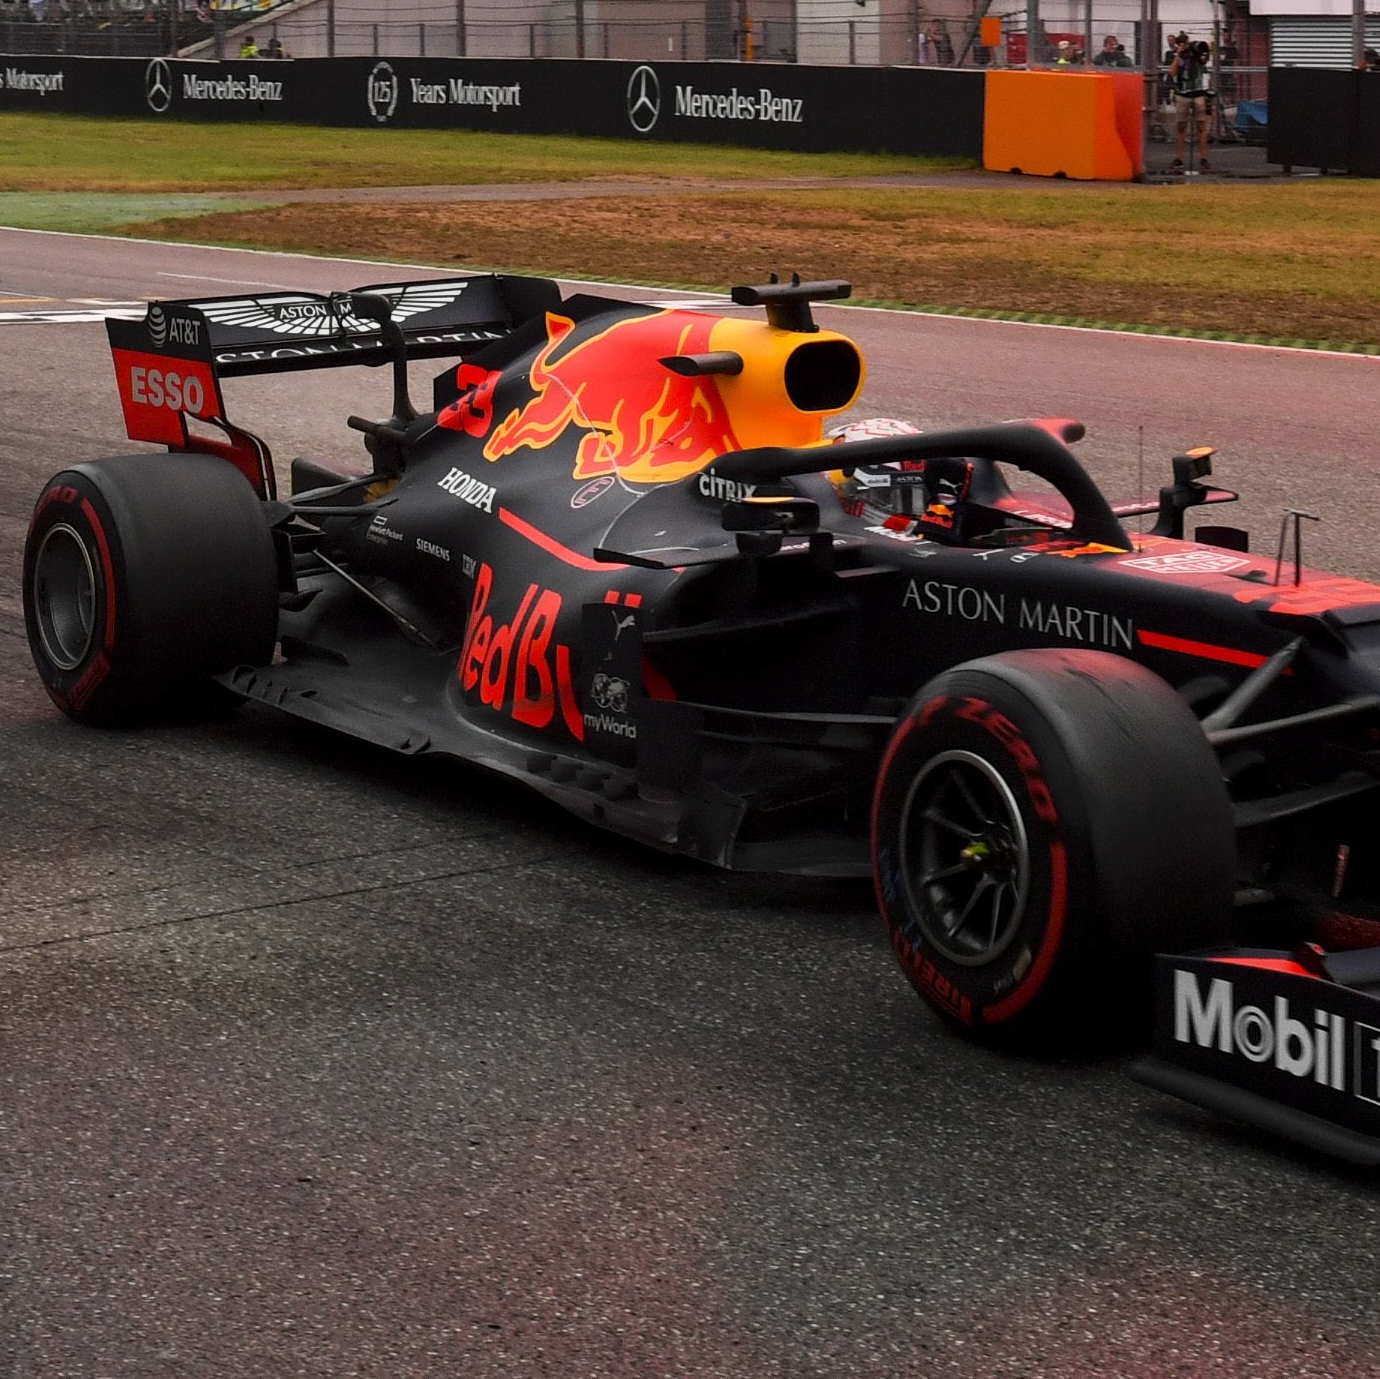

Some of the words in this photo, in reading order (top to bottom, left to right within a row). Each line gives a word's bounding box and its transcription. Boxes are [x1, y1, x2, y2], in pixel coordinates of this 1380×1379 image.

[5, 67, 65, 96] Motorsport
[182, 74, 283, 101] Mercedes-Benz
[374, 81, 391, 103] 125
[410, 77, 447, 103] Years
[448, 78, 522, 113] Motorsport
[674, 85, 804, 123] Mercedes-Benz
[279, 304, 328, 319] ASTON
[169, 317, 201, 345] AT&T
[131, 366, 204, 414] ESSO
[437, 467, 497, 513] HONDA
[416, 538, 450, 561] SIEMENS
[902, 578, 1005, 624] ASTON
[1019, 598, 1133, 651] MARTIN
[583, 713, 637, 739] myWorld
[1174, 968, 1347, 1092] Mobil
